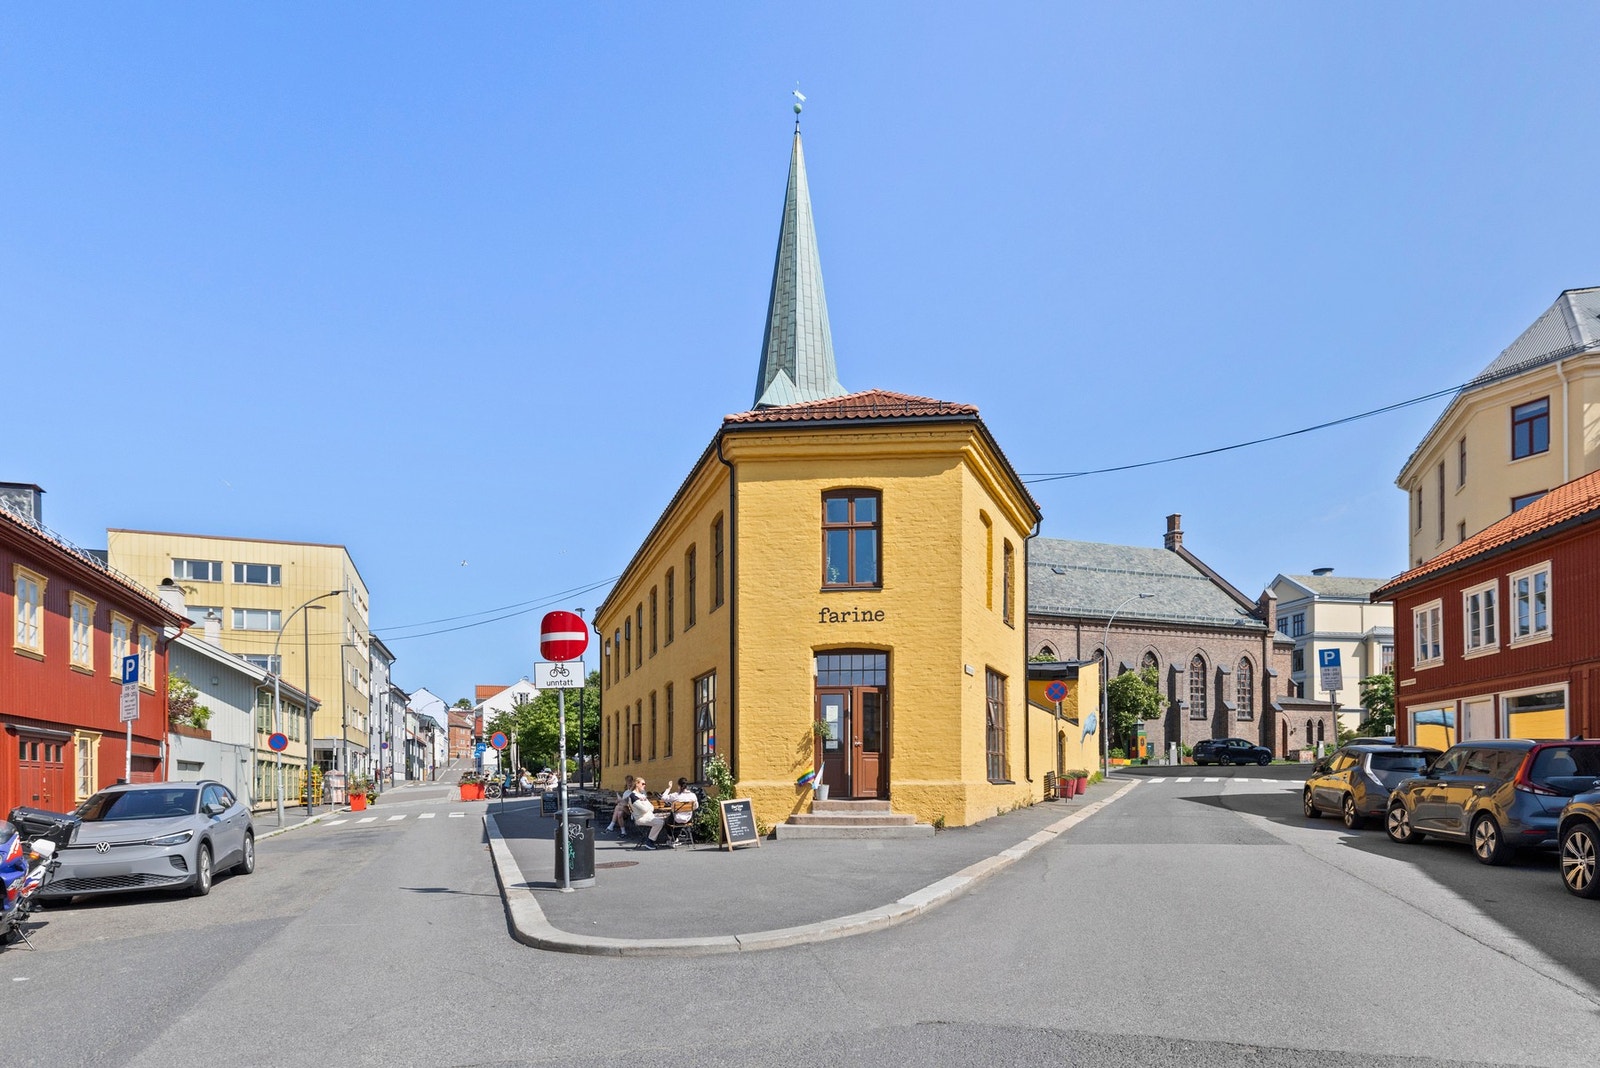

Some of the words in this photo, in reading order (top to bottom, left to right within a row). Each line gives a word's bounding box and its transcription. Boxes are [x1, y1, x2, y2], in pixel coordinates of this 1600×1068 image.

[818, 607, 885, 623] farine
[1324, 651, 1335, 664] P
[126, 658, 135, 680] P
